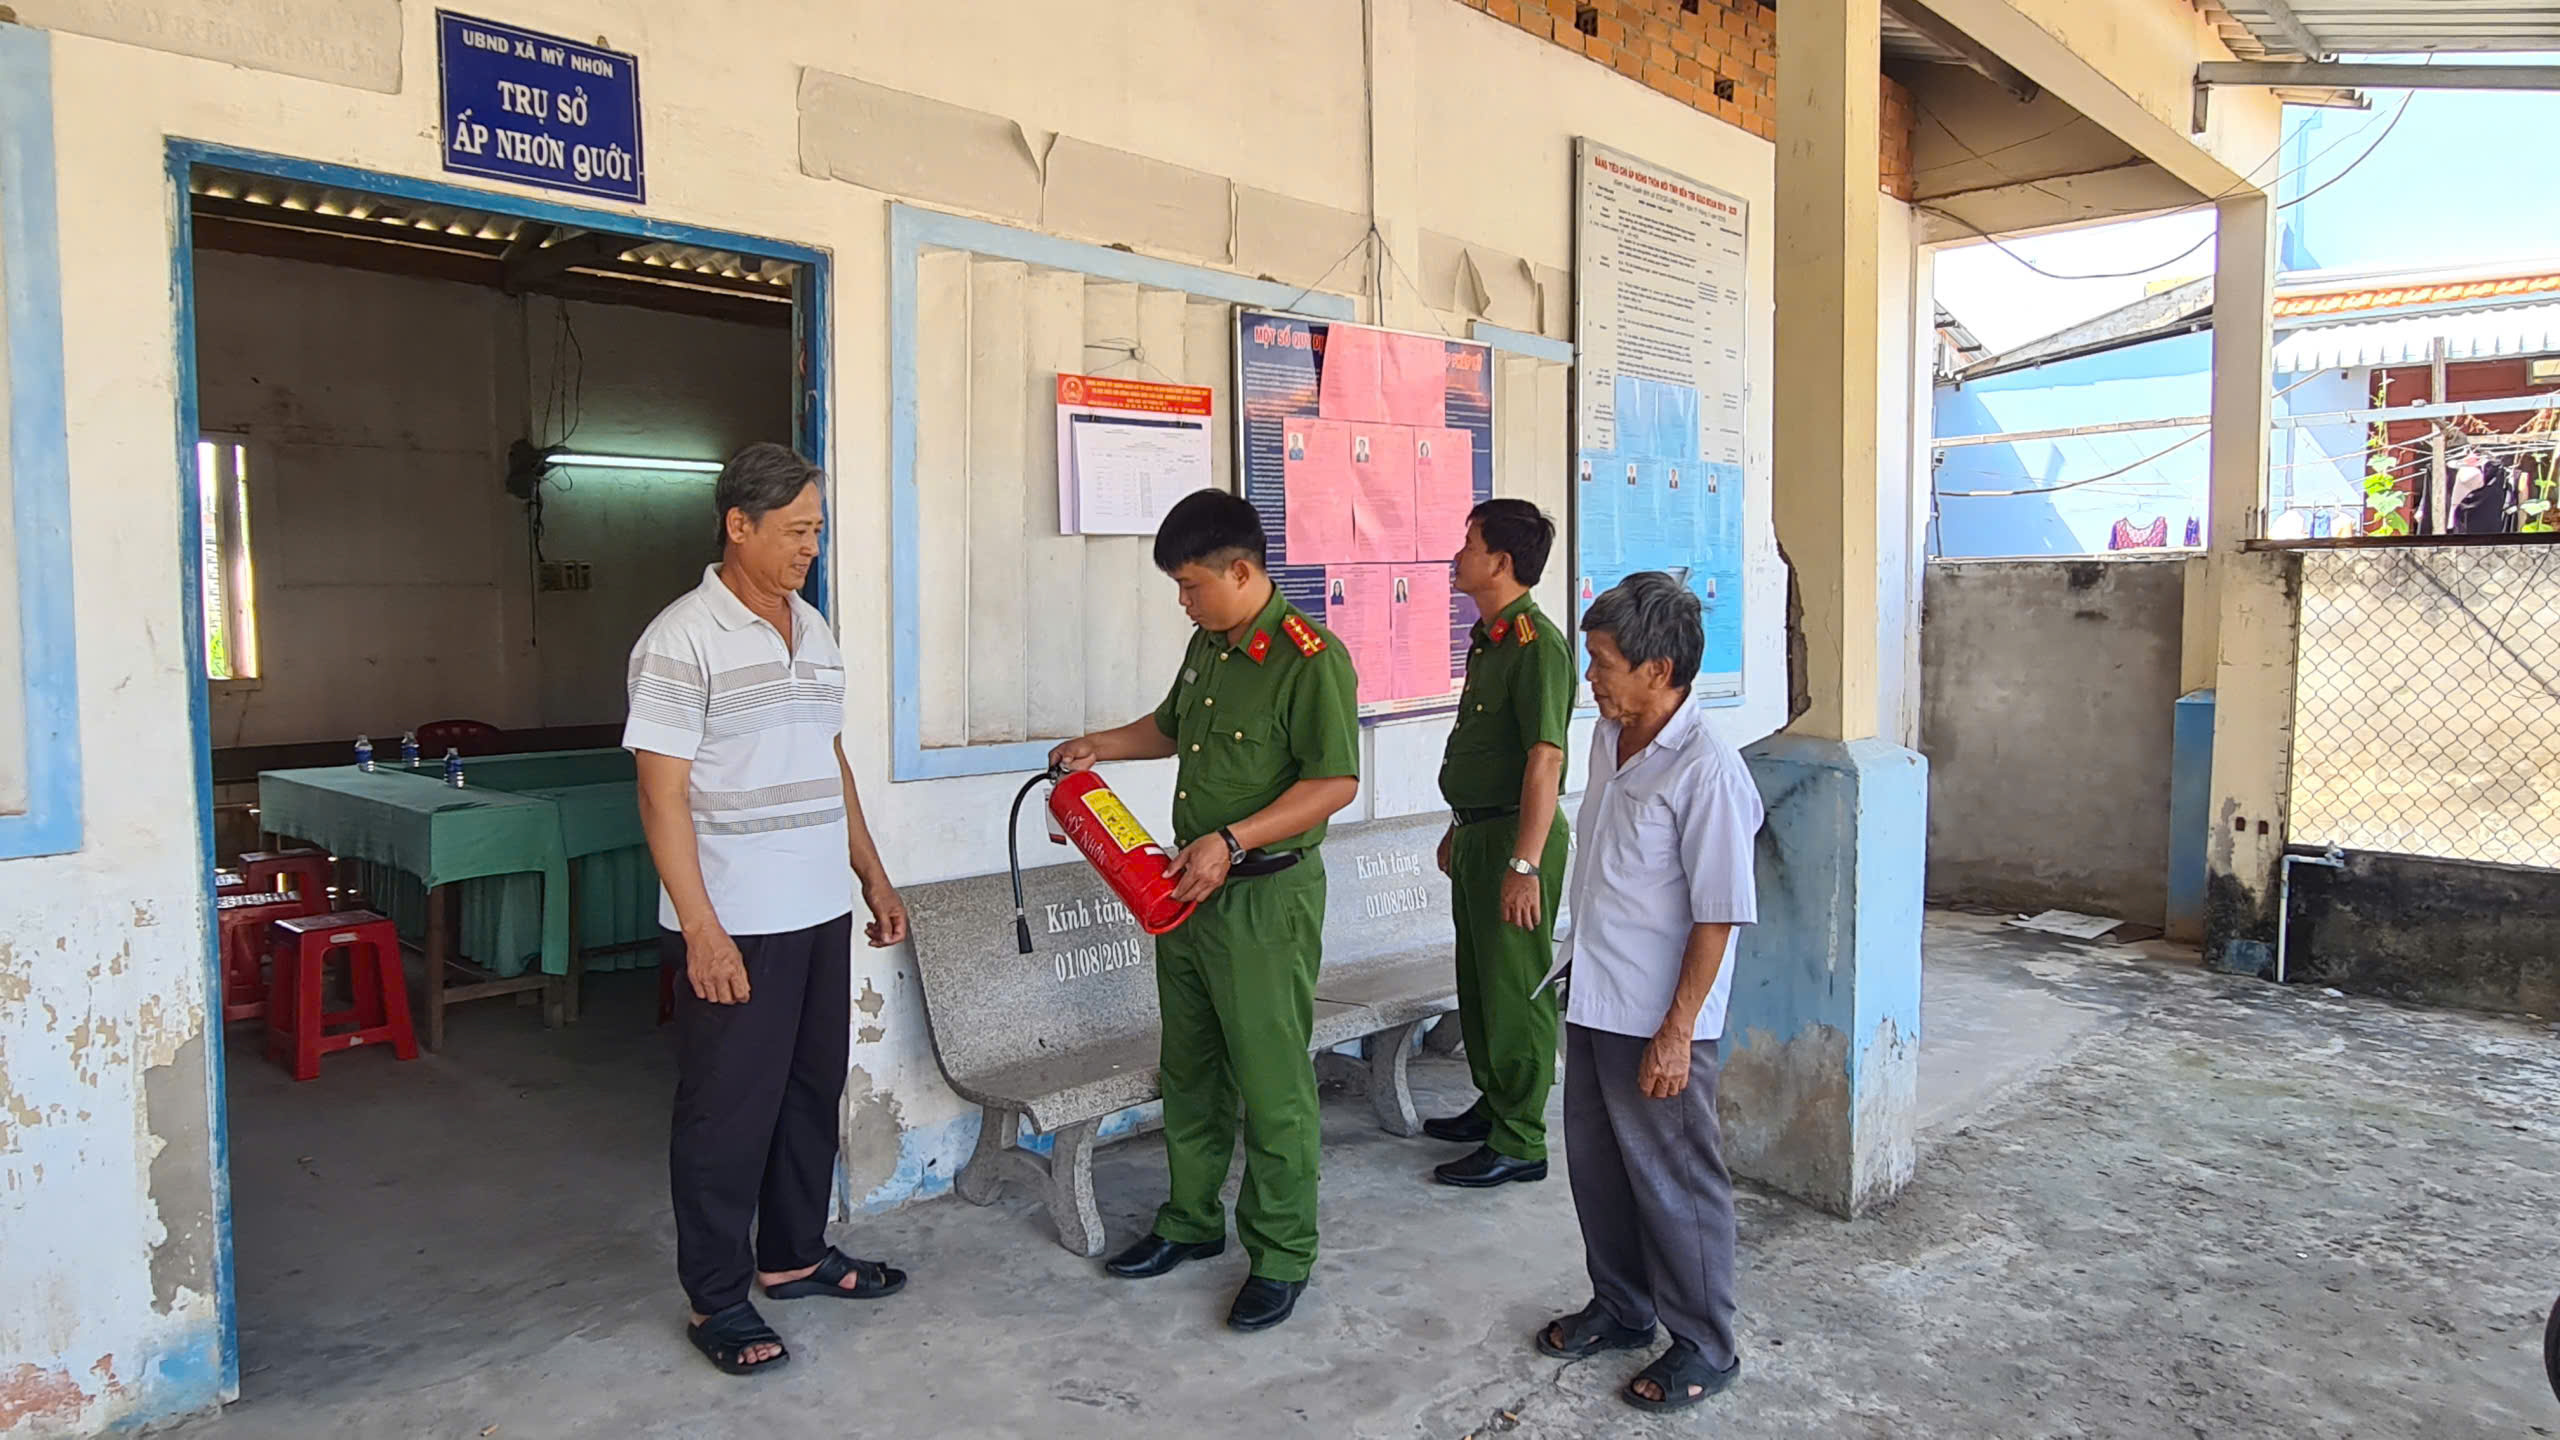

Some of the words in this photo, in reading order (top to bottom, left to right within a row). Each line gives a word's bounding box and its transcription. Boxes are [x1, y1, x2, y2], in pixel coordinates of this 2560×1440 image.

[462, 29, 509, 54] UBND
[514, 41, 536, 60] XÃ
[541, 47, 565, 67] MỸ
[571, 54, 614, 79] NHƠN
[497, 80, 549, 125] TRỤ
[557, 85, 588, 127] SỞ
[452, 108, 489, 155] ẤP
[495, 128, 565, 170] NHƠN
[573, 142, 633, 182] QUỚI
[1254, 323, 1276, 350] MỘT
[1277, 324, 1292, 348] SỐ
[1356, 852, 1389, 880] Kính
[1390, 850, 1421, 879] tặng
[1044, 899, 1091, 933] Kính
[1366, 886, 1428, 918] 01/08/2019
[1055, 938, 1141, 983] 01/08/2019
